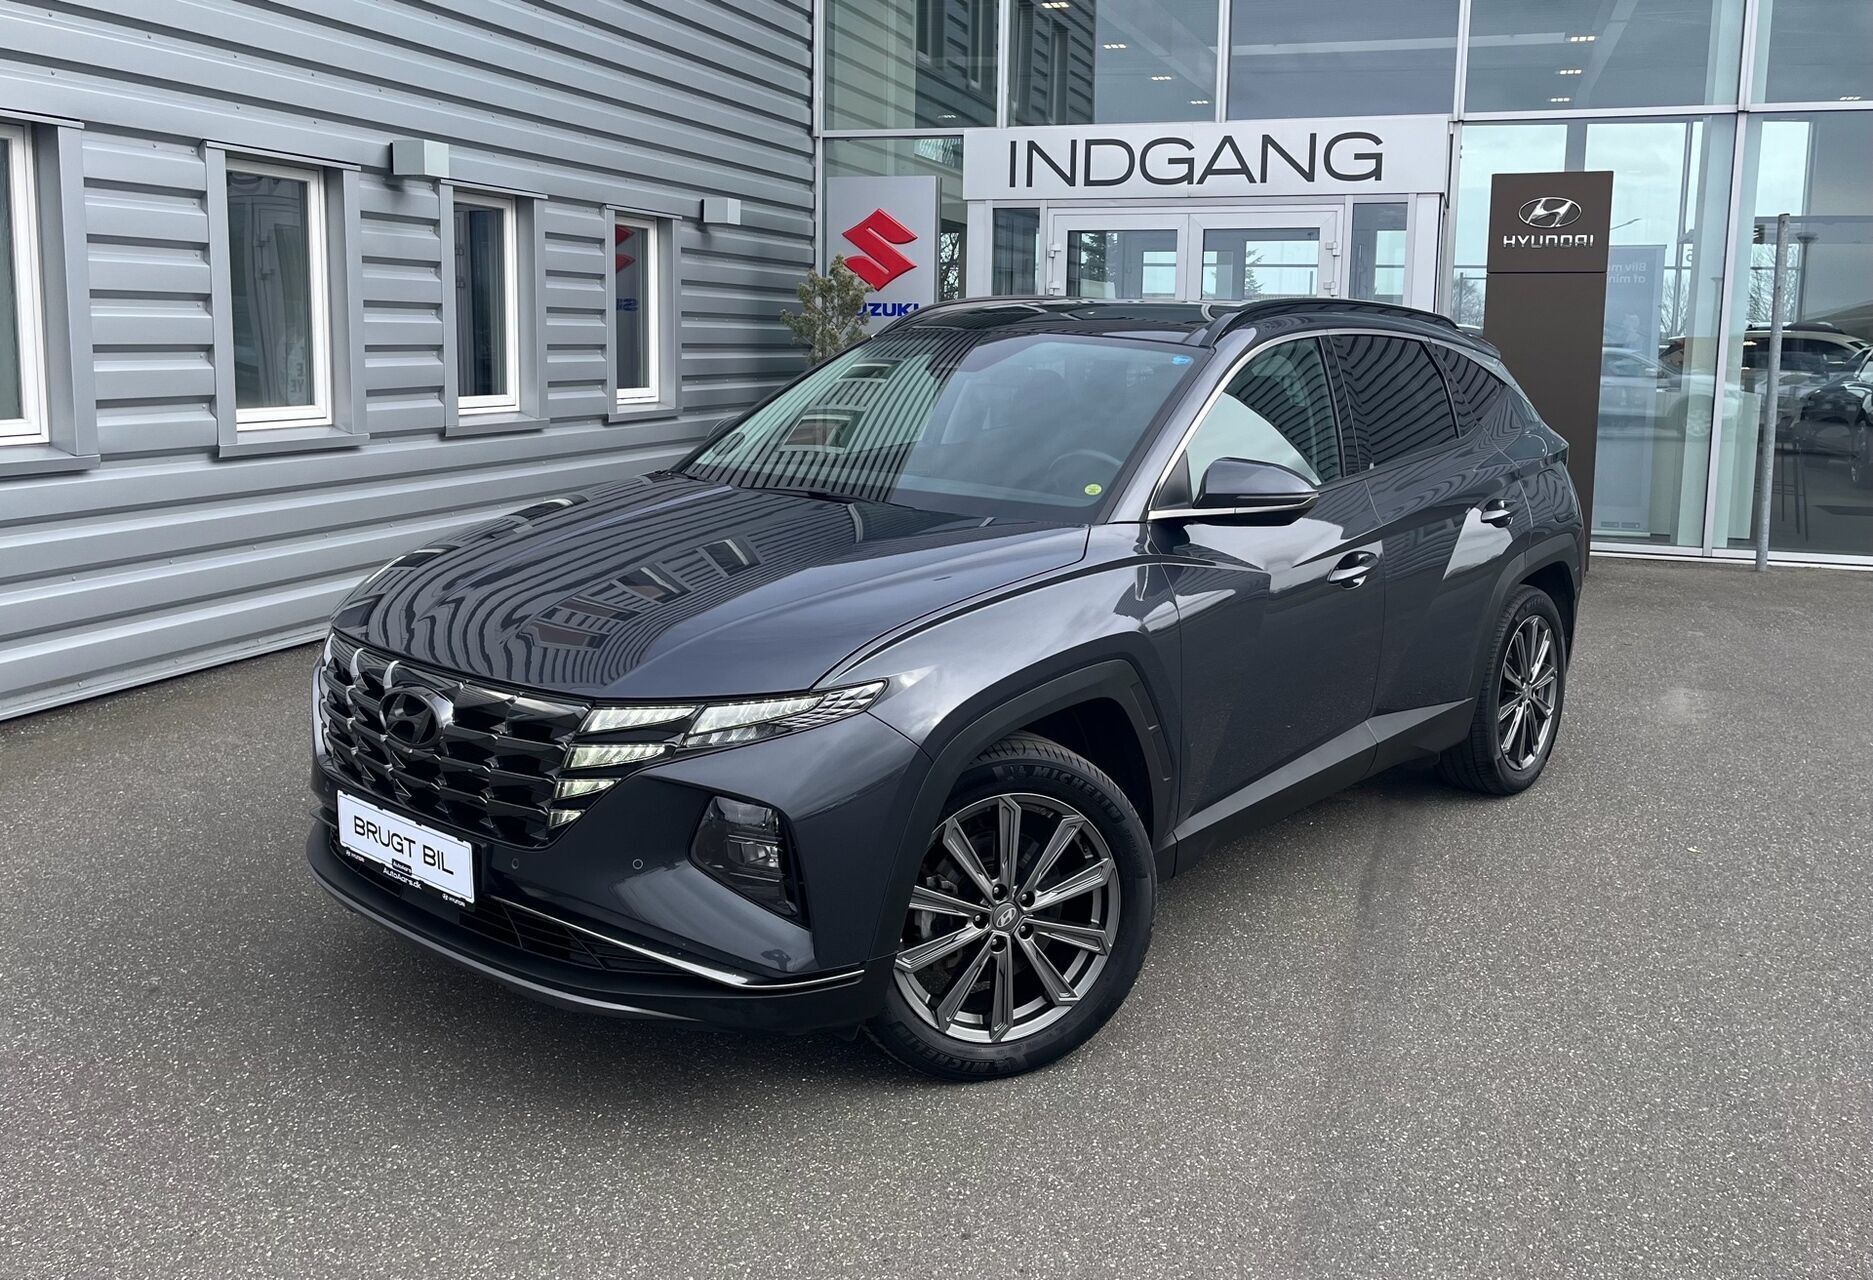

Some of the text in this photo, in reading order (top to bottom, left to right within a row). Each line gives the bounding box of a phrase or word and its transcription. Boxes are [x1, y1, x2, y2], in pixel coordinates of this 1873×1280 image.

[1009, 132, 1383, 188] INDGANG
[1503, 234, 1594, 249] HYUNDAI
[856, 302, 920, 317] UZUK
[1032, 766, 1126, 823] MICHELIN
[353, 815, 454, 876] BRUGT BIL
